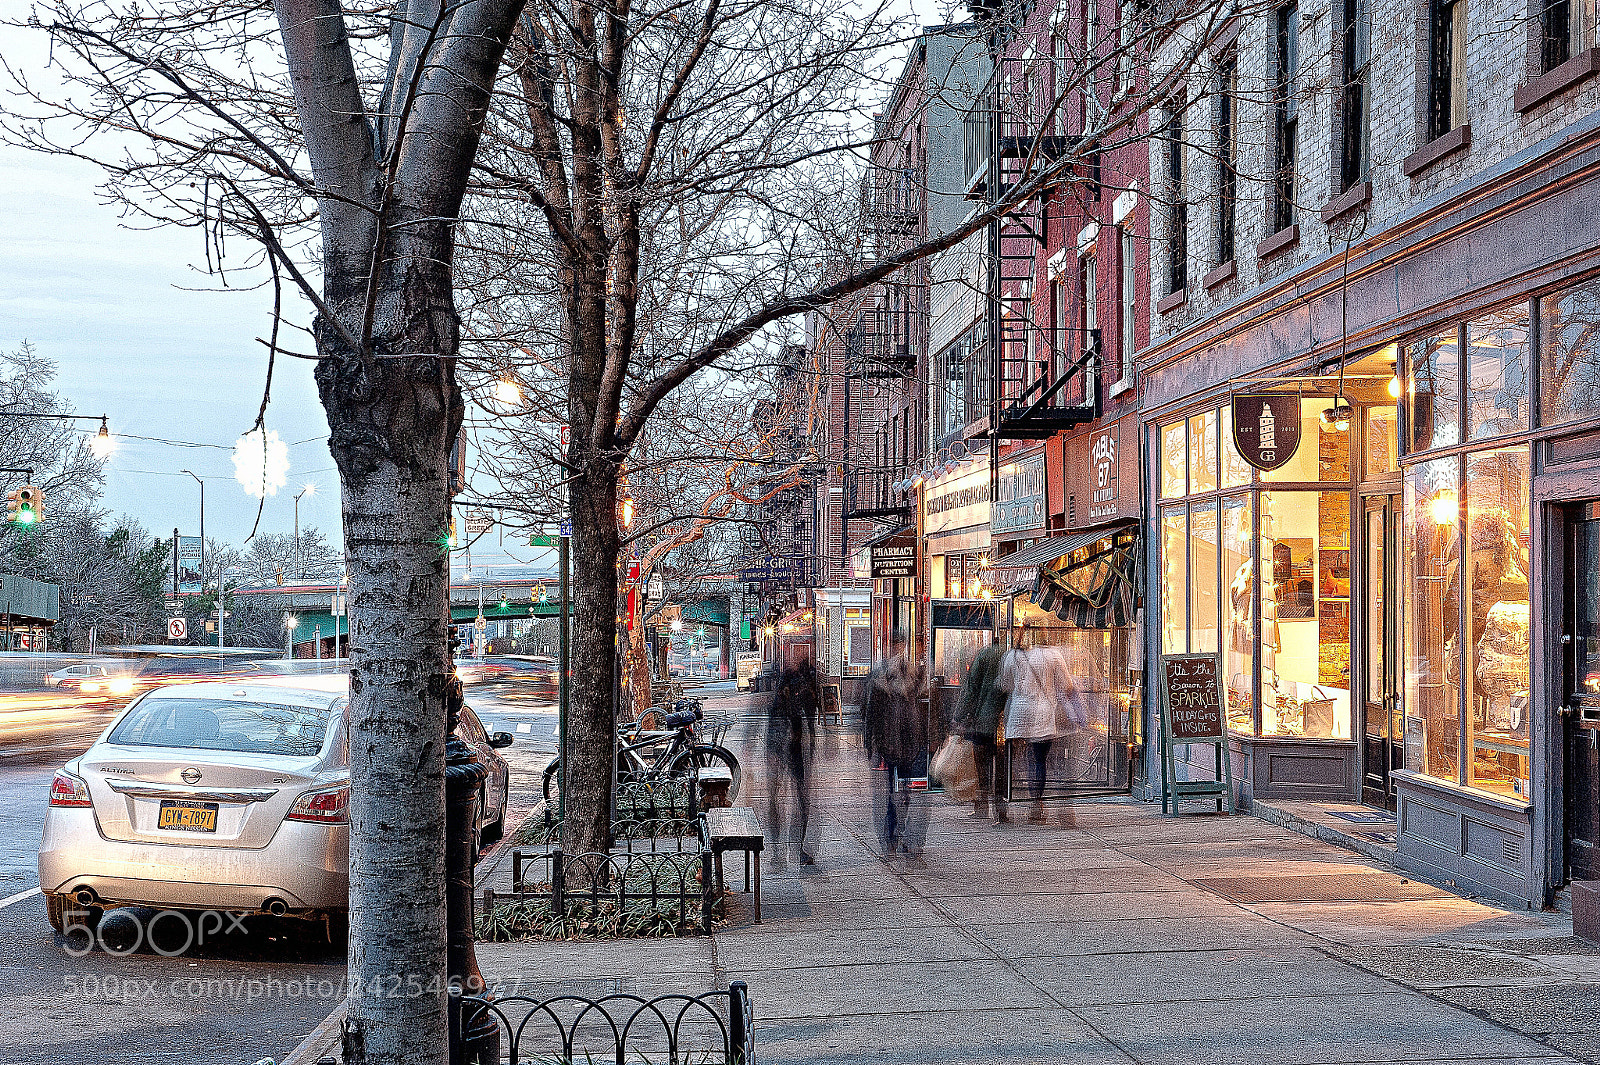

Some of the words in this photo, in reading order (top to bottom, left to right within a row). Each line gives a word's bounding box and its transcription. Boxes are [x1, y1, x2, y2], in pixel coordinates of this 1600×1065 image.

[1092, 435, 1115, 467] TABLE
[1098, 461, 1110, 488] 87
[873, 546, 914, 557] PHARMACY
[874, 559, 914, 568] NUTRITION
[880, 568, 909, 576] CENTER
[1192, 662, 1216, 677] the
[1170, 692, 1219, 708] SPARKLE
[1172, 709, 1198, 723] HOLIDAY
[100, 766, 135, 775] ALTIMA
